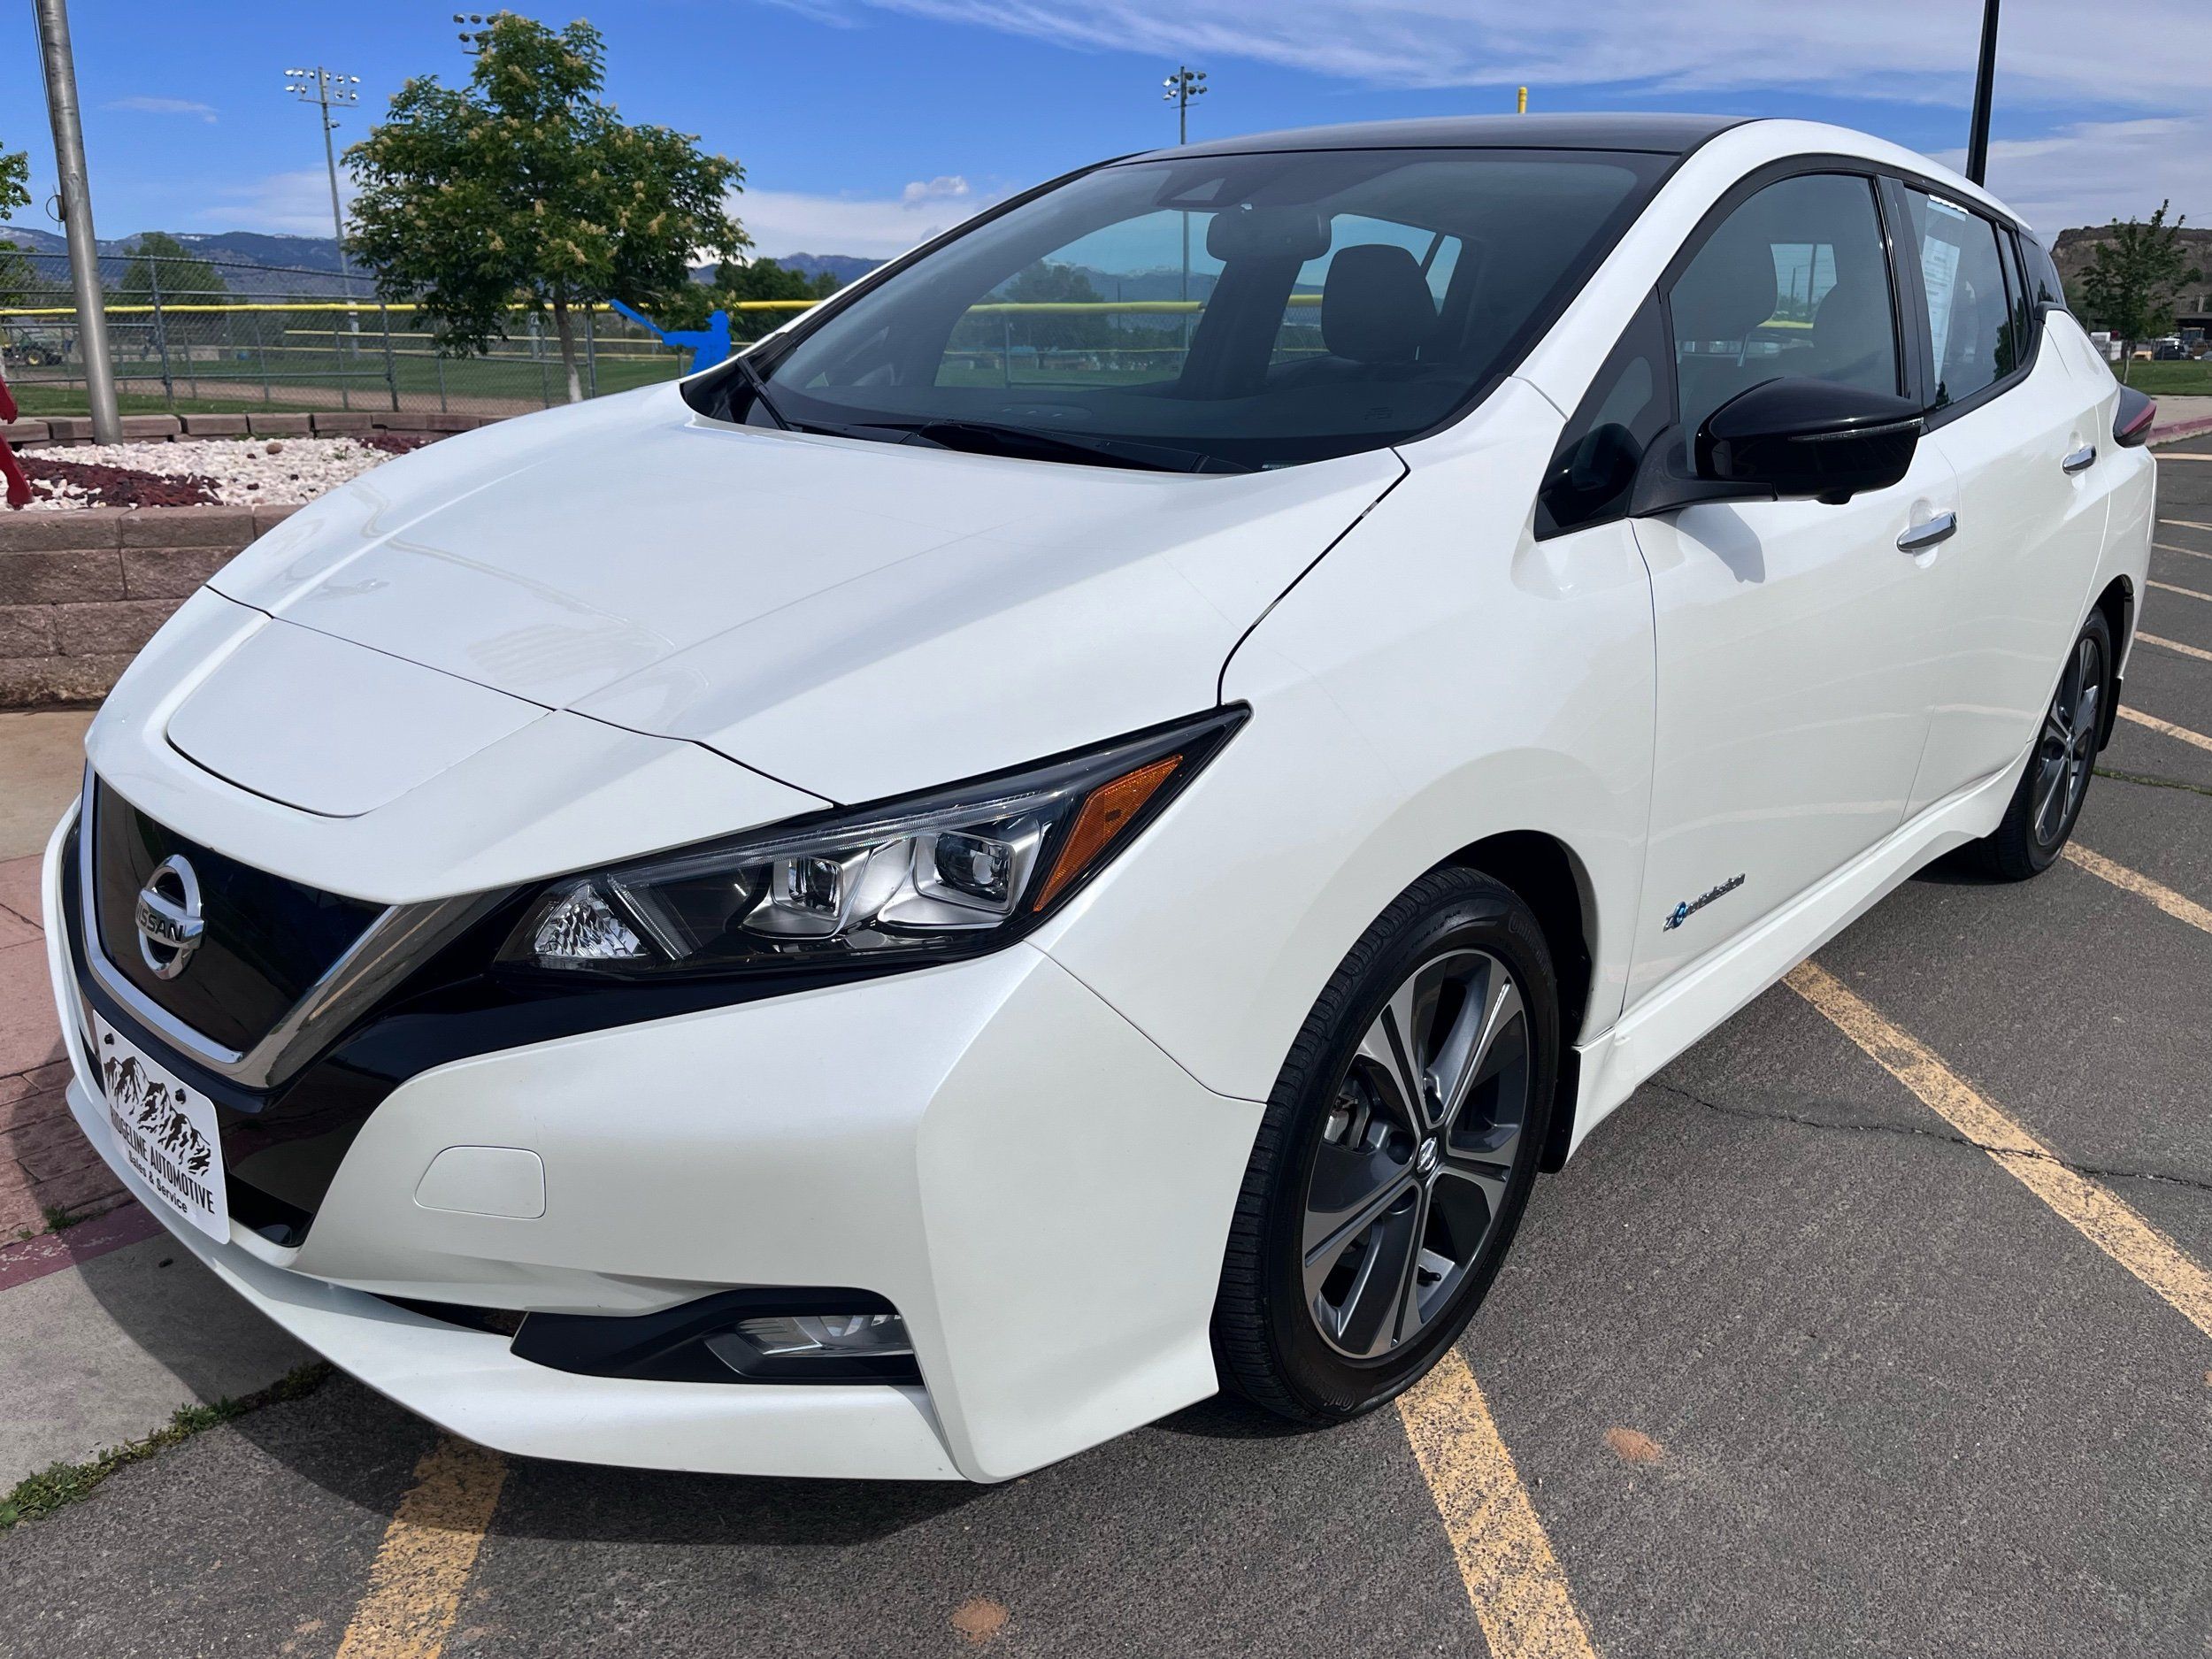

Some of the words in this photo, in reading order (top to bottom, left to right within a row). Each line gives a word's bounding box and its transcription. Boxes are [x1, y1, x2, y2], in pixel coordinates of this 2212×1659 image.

[136, 902, 184, 942] NISSAN
[109, 1103, 149, 1162] RIDGELINE
[150, 1145, 215, 1215] AUTOMOTIVE
[128, 1149, 147, 1178] Sales
[149, 1171, 155, 1186] &
[156, 1178, 188, 1213] Service
